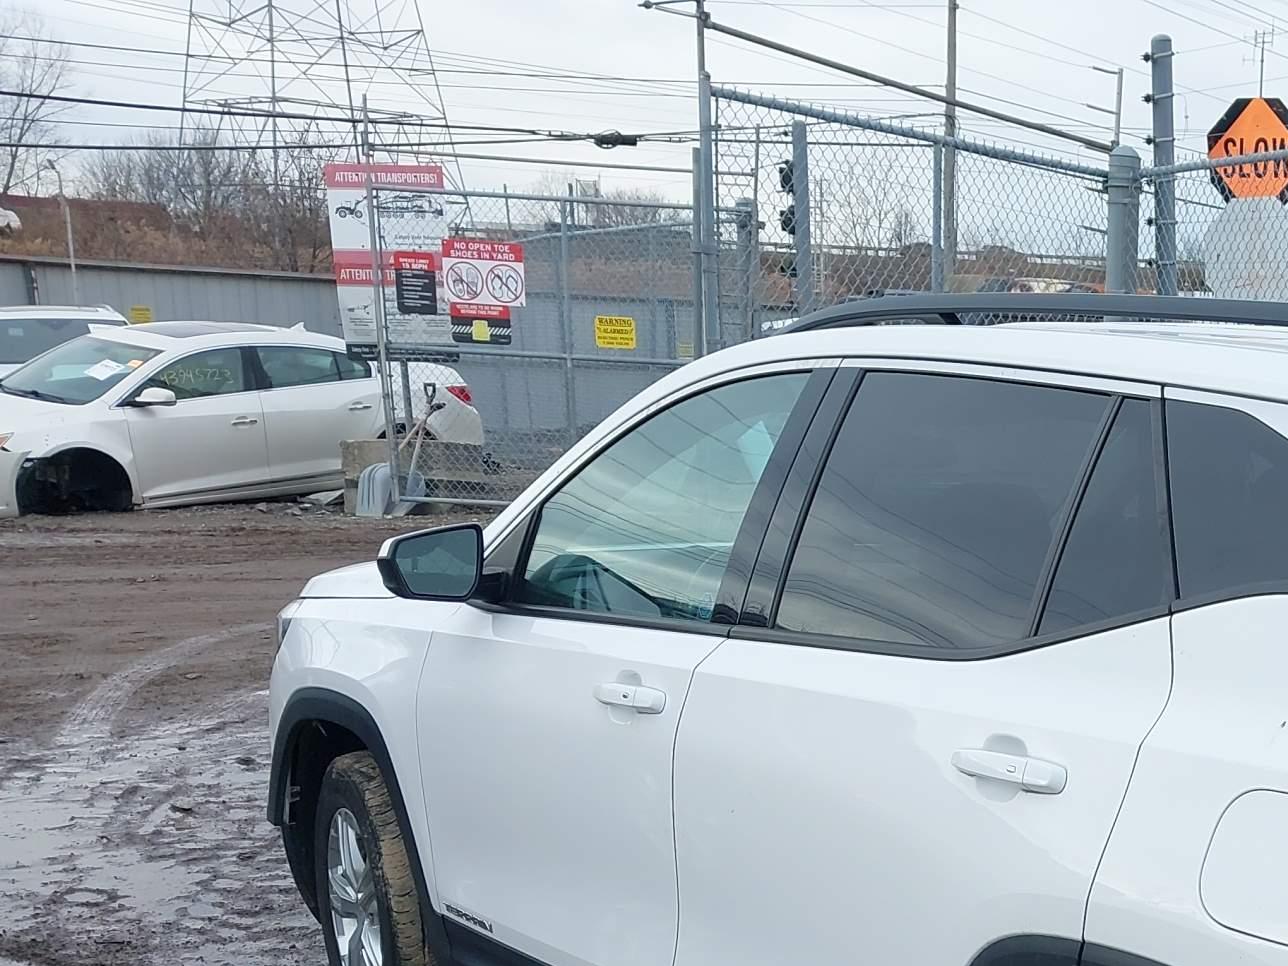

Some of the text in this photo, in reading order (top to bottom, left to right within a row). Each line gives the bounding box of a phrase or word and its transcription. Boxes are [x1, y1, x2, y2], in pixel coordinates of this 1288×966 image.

[335, 171, 375, 183] ATTENTIN
[468, 243, 491, 252] OPEN
[493, 245, 510, 253] TOE
[450, 250, 515, 260] SHOES IN YARD
[597, 317, 632, 327] WARNING
